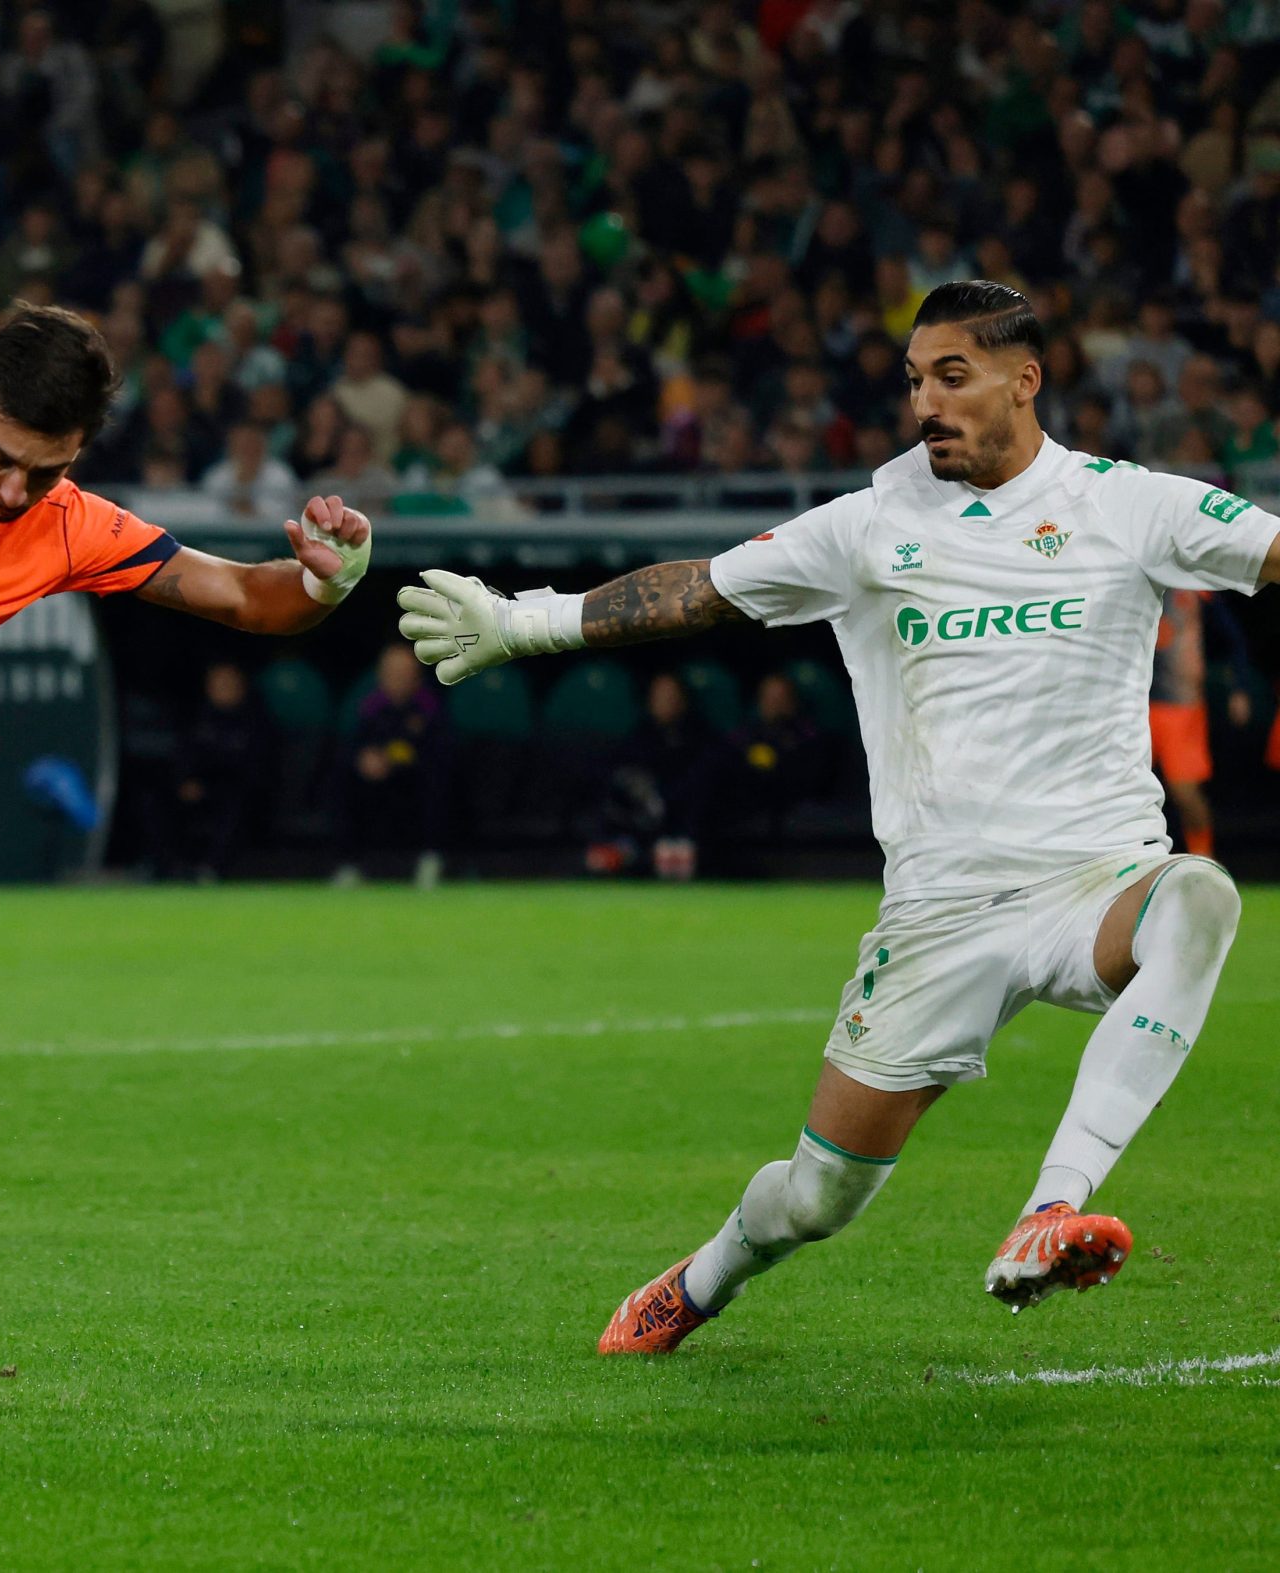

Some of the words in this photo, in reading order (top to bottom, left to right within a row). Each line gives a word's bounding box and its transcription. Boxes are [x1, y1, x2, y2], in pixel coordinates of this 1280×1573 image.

[892, 560, 923, 573] hummel
[937, 598, 1086, 641] GREE
[862, 947, 890, 1001] 1
